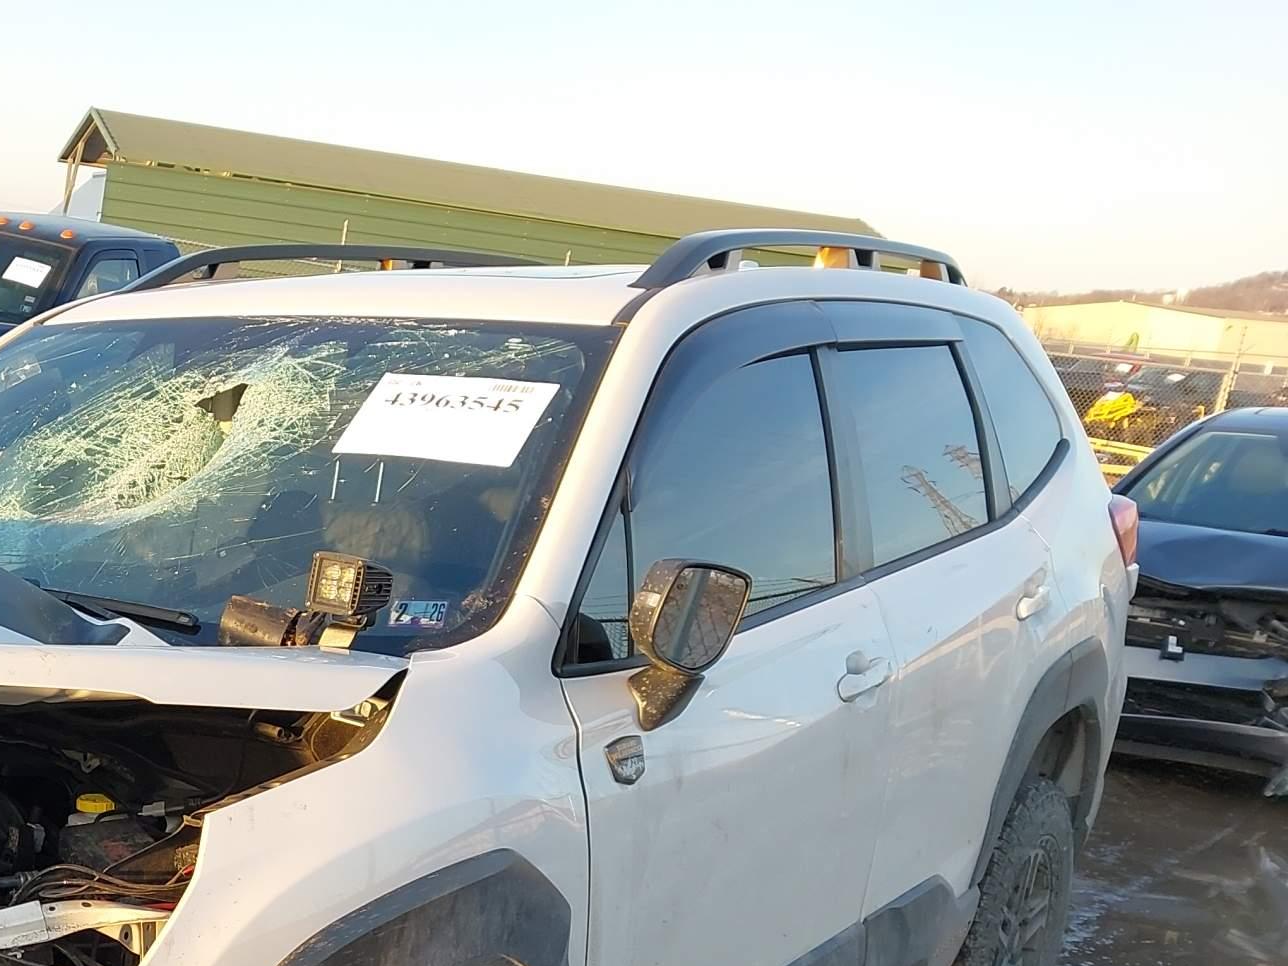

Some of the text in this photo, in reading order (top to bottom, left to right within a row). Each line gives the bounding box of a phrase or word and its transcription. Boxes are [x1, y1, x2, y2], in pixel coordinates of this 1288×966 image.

[385, 391, 525, 414] 43963545
[395, 602, 446, 623] 2 26
